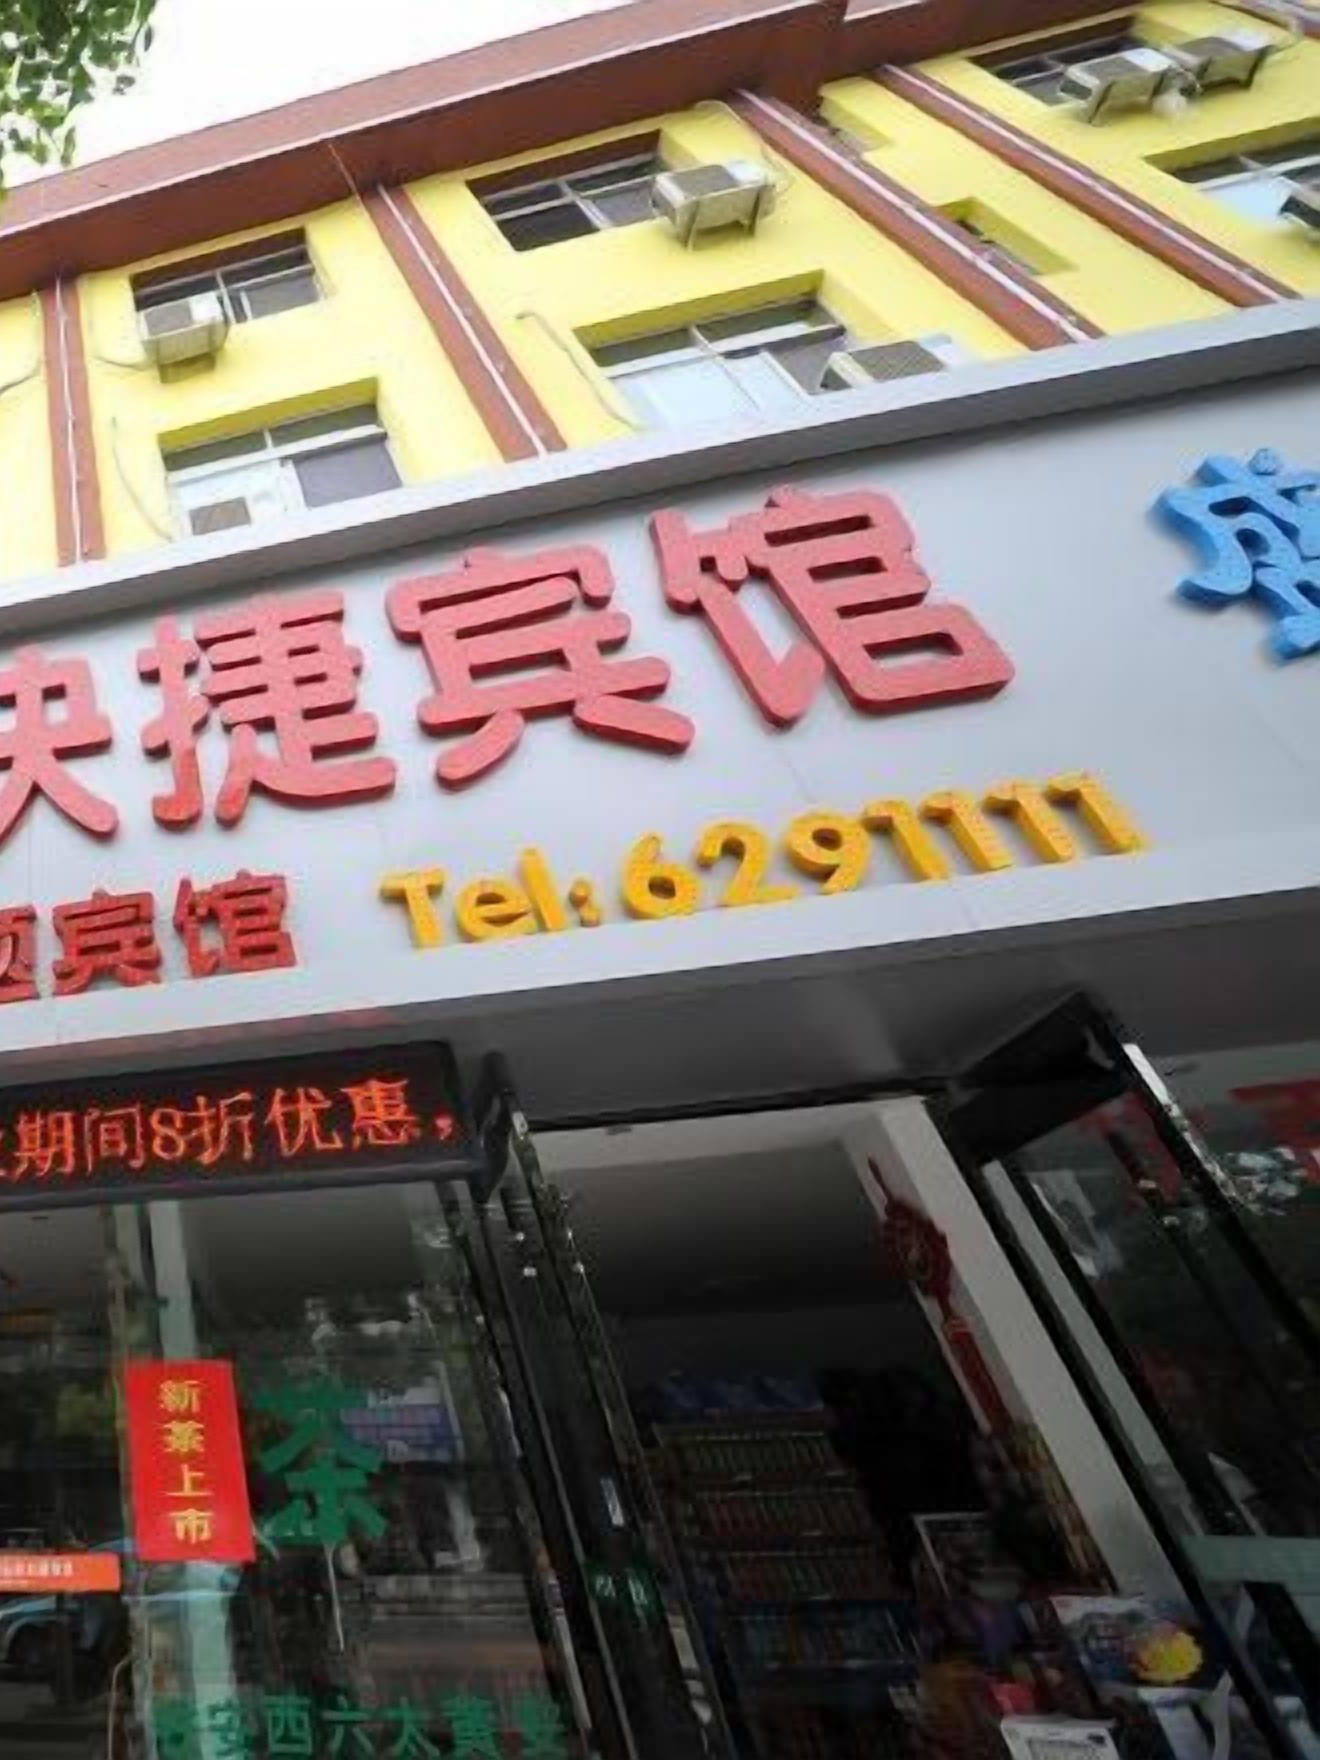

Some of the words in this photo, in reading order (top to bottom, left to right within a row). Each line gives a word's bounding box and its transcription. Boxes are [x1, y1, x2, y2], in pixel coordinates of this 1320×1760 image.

[380, 848, 602, 950] Tel:
[620, 774, 1146, 922] 6291111
[158, 1379, 215, 1544] 新茶上市
[255, 1377, 387, 1546] 茶
